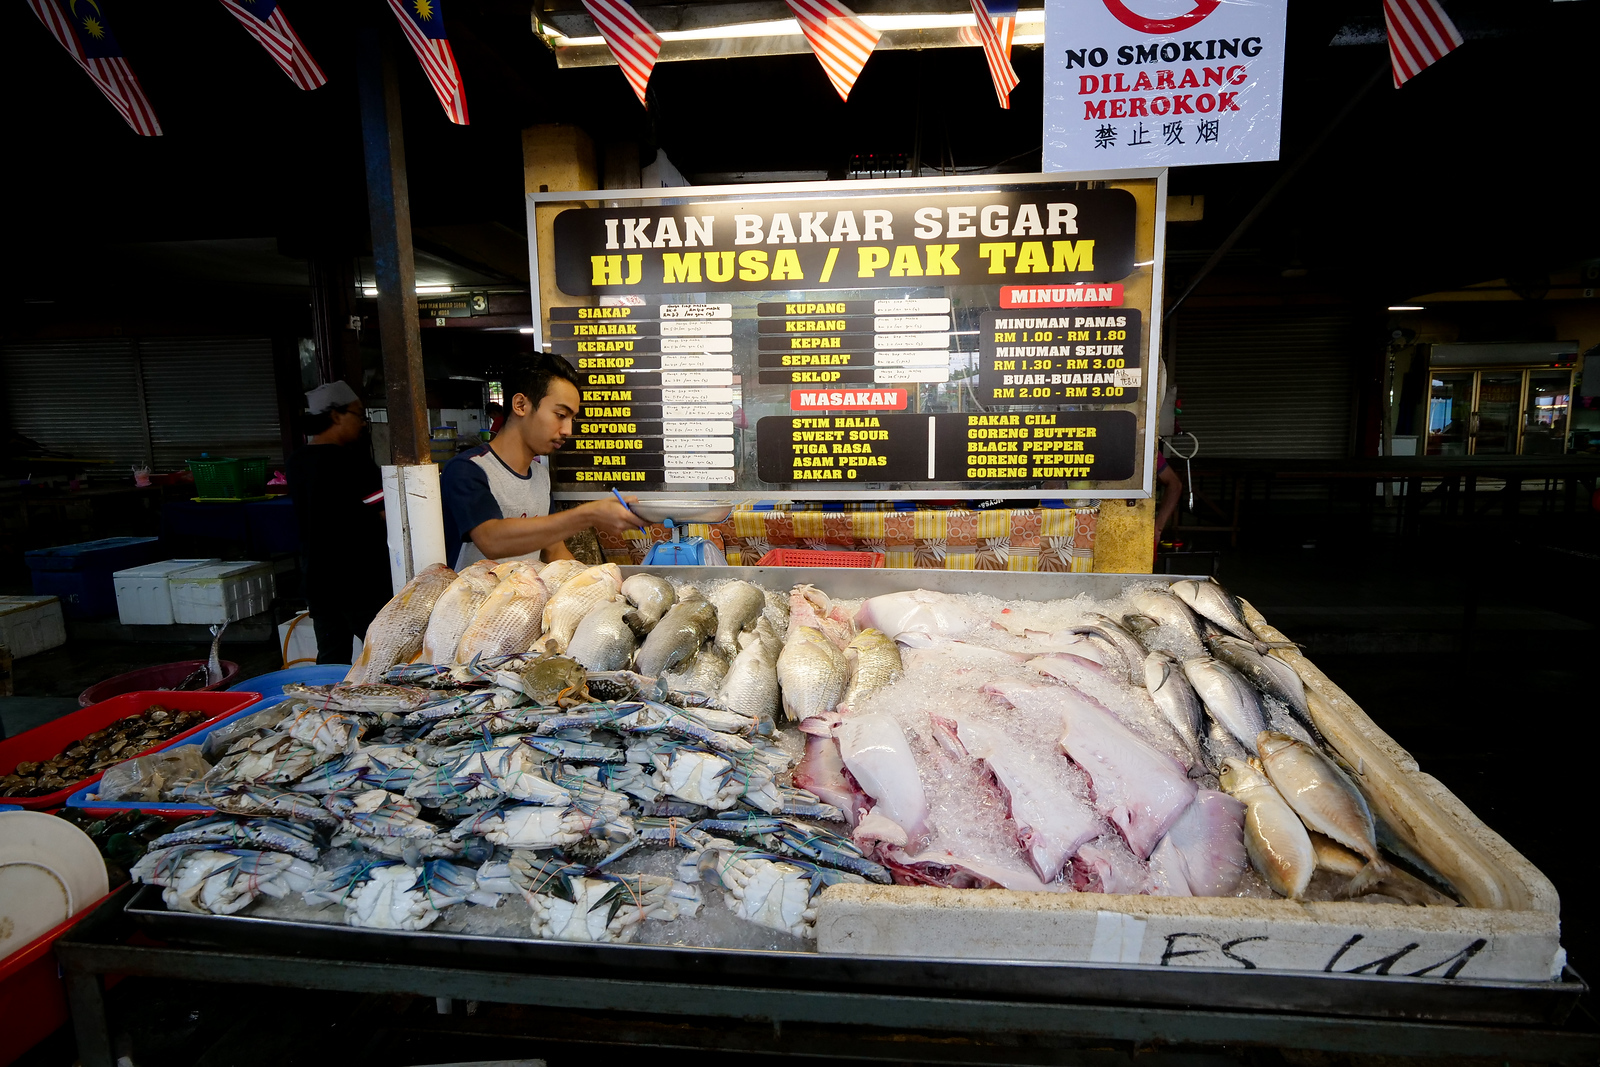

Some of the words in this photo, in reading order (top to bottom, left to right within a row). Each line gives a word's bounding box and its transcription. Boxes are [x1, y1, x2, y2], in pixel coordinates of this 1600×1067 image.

[1065, 48, 1108, 69] NO
[1117, 37, 1262, 65] SMOKING
[1078, 65, 1247, 95] DILARANG
[1084, 92, 1241, 120] MEROKOK
[1094, 119, 1219, 149] 禁止吸烟
[605, 216, 715, 250] IKAN
[734, 209, 894, 246] BAKAR
[914, 203, 1078, 239] SEGAR
[591, 254, 643, 285] HJ
[663, 249, 804, 283] MUSA
[819, 248, 840, 282] /
[857, 244, 960, 278] PAK
[979, 240, 1094, 274] TAM
[1011, 288, 1112, 303] MINUMAN
[473, 296, 485, 311] 3
[786, 303, 846, 314] KUPANG
[578, 308, 631, 318] SIAKAP
[438, 318, 443, 326] 3
[786, 320, 846, 331] KERANG
[995, 318, 1069, 329] MINUMAN
[1075, 317, 1126, 327] PANAS
[574, 324, 637, 335] JENAHAK
[995, 332, 1016, 342] RM
[1023, 332, 1052, 342] 1.00
[1068, 331, 1091, 341] RM
[1096, 330, 1126, 340] 1.80
[578, 341, 633, 351] KERAPU
[791, 337, 841, 348] KEPAH
[996, 346, 1070, 357] MINUMAN
[1076, 345, 1123, 355] SEJUK
[579, 358, 634, 368] SERKOP
[782, 354, 850, 365] SEPAHAT
[994, 360, 1015, 370] RM
[1022, 360, 1051, 370] 1.30
[1067, 359, 1088, 369] RM
[1093, 359, 1124, 369] 3.00
[589, 375, 625, 384] CARU
[792, 372, 840, 382] SKLOP
[1003, 373, 1114, 386] BUAH-BUAHAN
[583, 391, 631, 400] KETAM
[993, 388, 1014, 398] RM
[1019, 388, 1050, 397] 2.00
[1066, 387, 1087, 397] RM
[1092, 387, 1123, 396] 3.00
[800, 392, 897, 405] MASAKAN
[585, 407, 631, 417] UDANG
[792, 418, 830, 428] STIM
[835, 417, 880, 427] HALIA
[968, 415, 1019, 425] BAKAR
[1025, 415, 1056, 425] CILI
[581, 424, 636, 433] SOTONG
[968, 428, 1028, 439] GORENG
[1034, 428, 1096, 438] BUTTER
[793, 431, 844, 441] SWEET
[849, 430, 888, 440] SOUR
[576, 440, 642, 449] KEMBONG
[793, 444, 828, 454] TIGA
[833, 444, 872, 453] RASA
[968, 442, 1017, 452] BLACK
[1023, 441, 1083, 451] PEPPER
[594, 456, 626, 465] PARI
[793, 457, 833, 466] ASAM
[839, 456, 887, 466] PEDAS
[968, 455, 1027, 465] GORENG
[1033, 454, 1094, 464] TEPUNG
[576, 472, 645, 481] SENANGIN
[793, 470, 842, 479] BAKAR
[967, 468, 1027, 477] GORENG
[1033, 467, 1090, 477] KUNYIT
